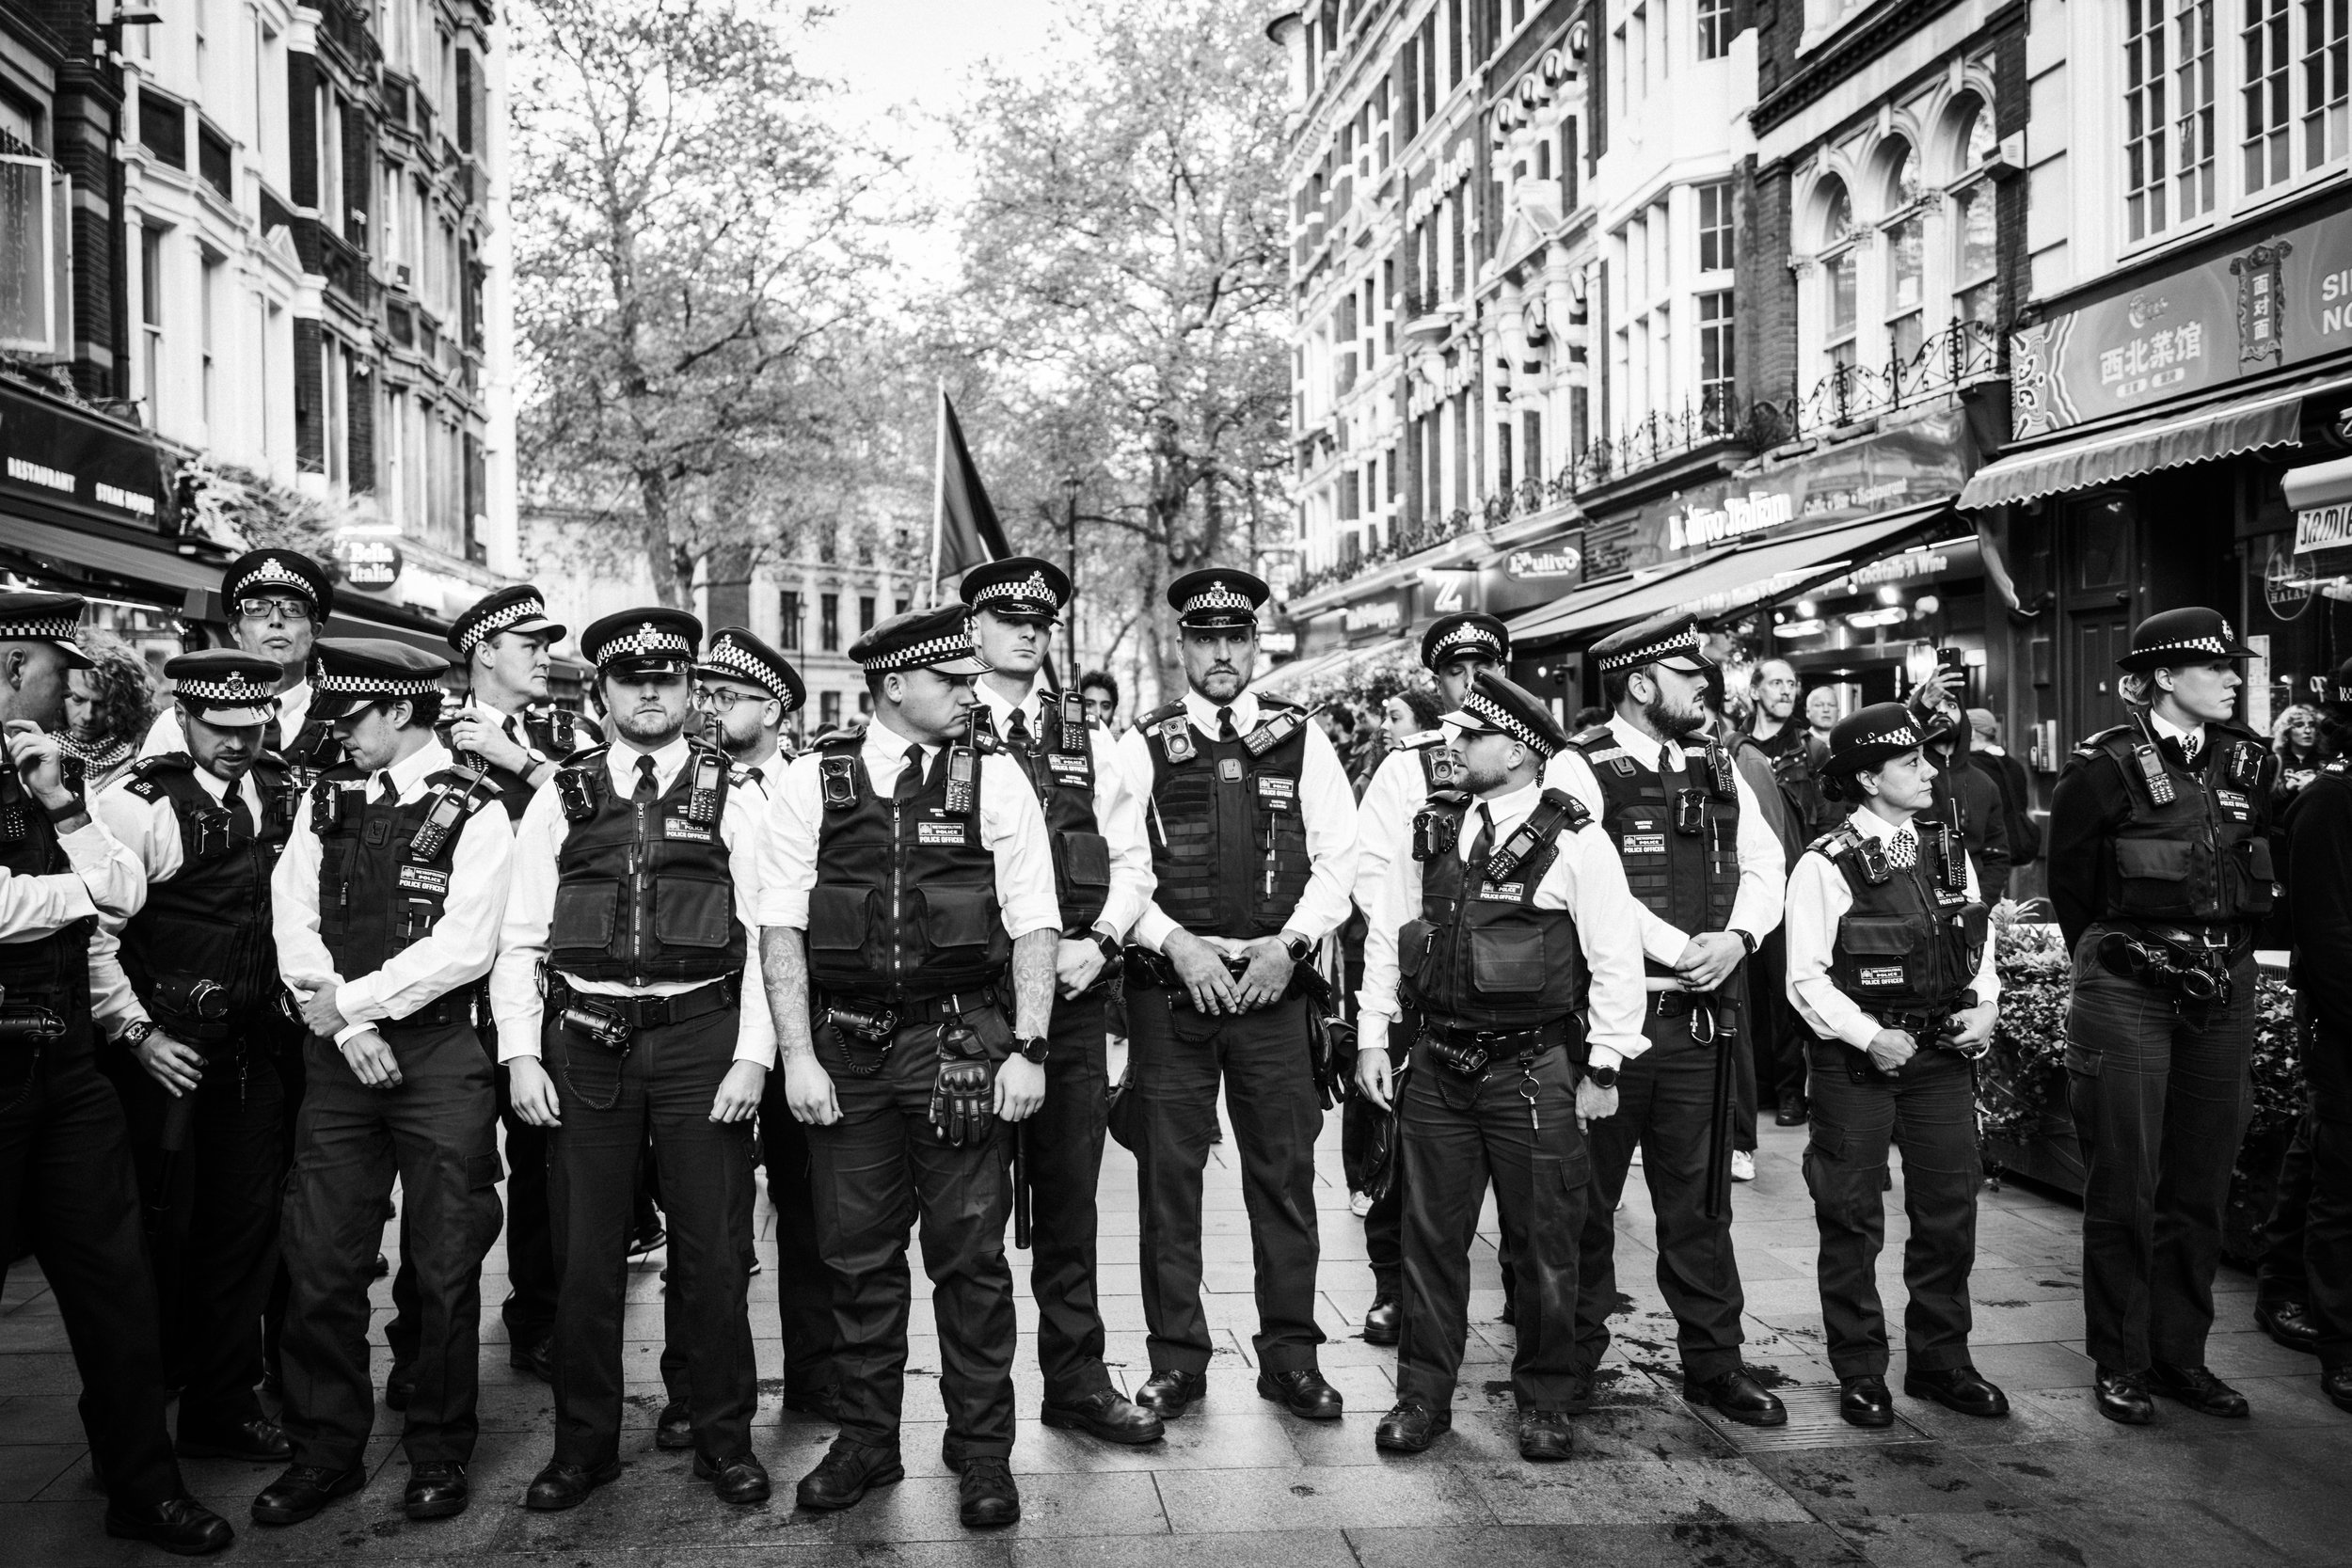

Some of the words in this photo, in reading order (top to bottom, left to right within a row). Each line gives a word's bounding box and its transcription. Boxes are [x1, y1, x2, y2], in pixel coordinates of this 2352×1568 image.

[2322, 269, 2352, 301] SI
[2252, 273, 2270, 341] 面对面
[2100, 321, 2202, 386] 西北菜馆
[8, 456, 75, 493] RESTAURANT
[349, 542, 395, 562] Bella
[349, 562, 395, 582] Italia
[2270, 589, 2308, 604] HALAL
[399, 879, 421, 889] POLICE
[421, 882, 446, 894] OFFICER
[418, 875, 441, 883] POLICE
